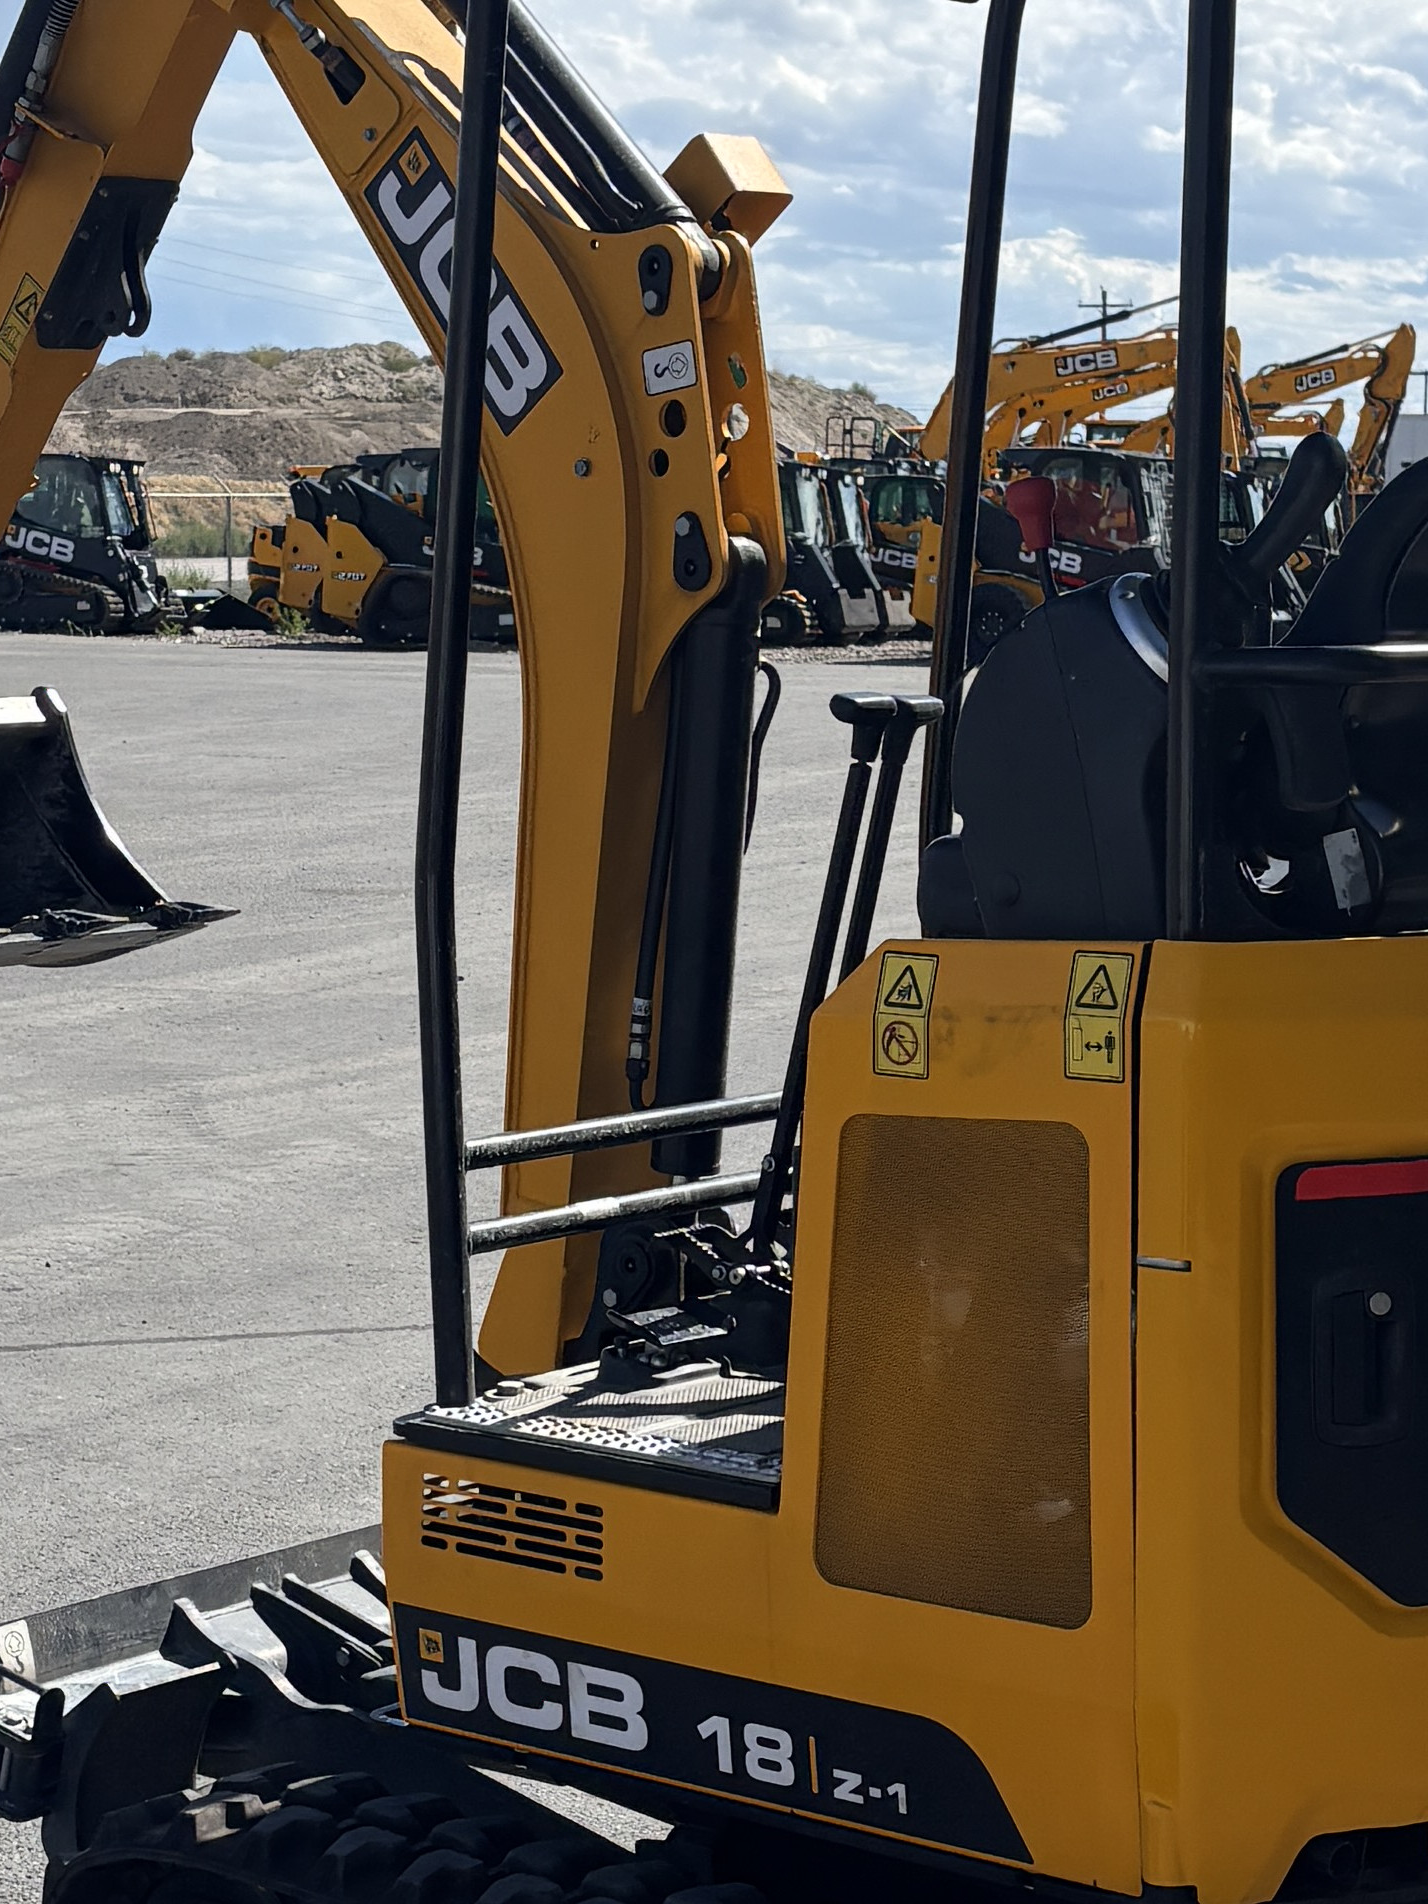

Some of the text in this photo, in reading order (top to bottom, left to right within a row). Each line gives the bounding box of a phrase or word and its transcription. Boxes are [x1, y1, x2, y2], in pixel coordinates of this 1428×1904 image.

[1057, 349, 1118, 376] JCB
[1093, 381, 1129, 401] JCB
[1297, 368, 1335, 392] JCB
[4, 526, 75, 563] JCB
[870, 548, 918, 569] JCB
[421, 1636, 649, 1752] JCB
[696, 1714, 796, 1787] 18
